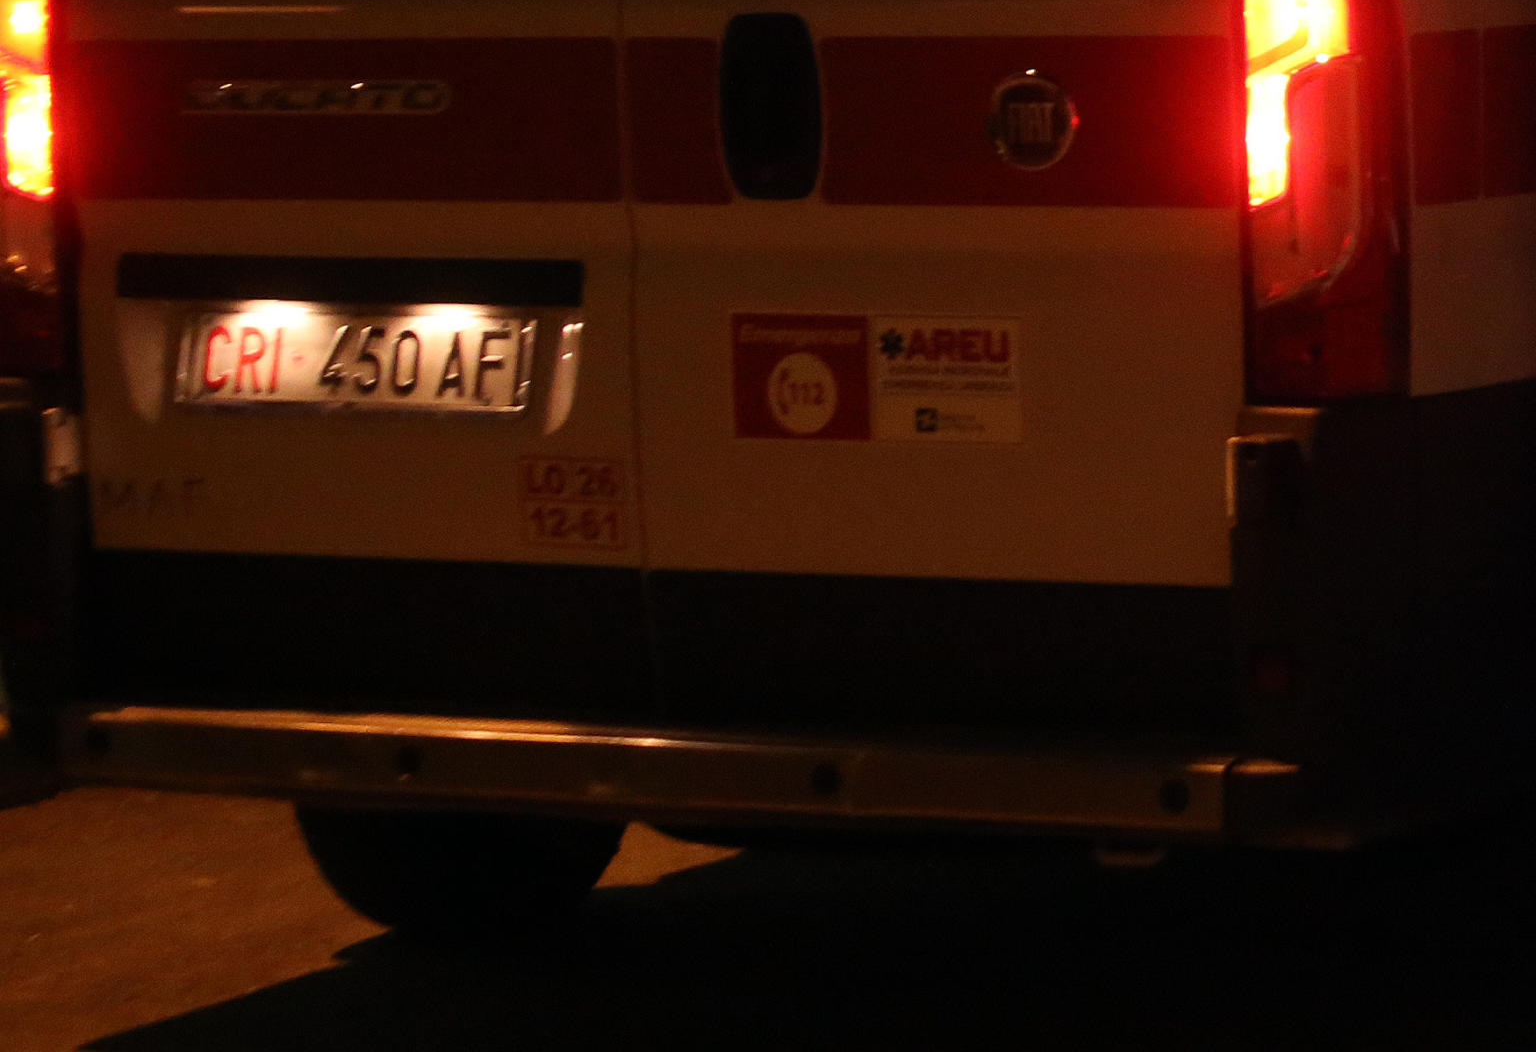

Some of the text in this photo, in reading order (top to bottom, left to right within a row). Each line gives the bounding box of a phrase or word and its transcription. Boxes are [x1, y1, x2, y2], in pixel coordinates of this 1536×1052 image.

[203, 324, 283, 395] CRI
[319, 324, 422, 396] 450
[905, 328, 1009, 363] AREU
[525, 462, 566, 495] LO
